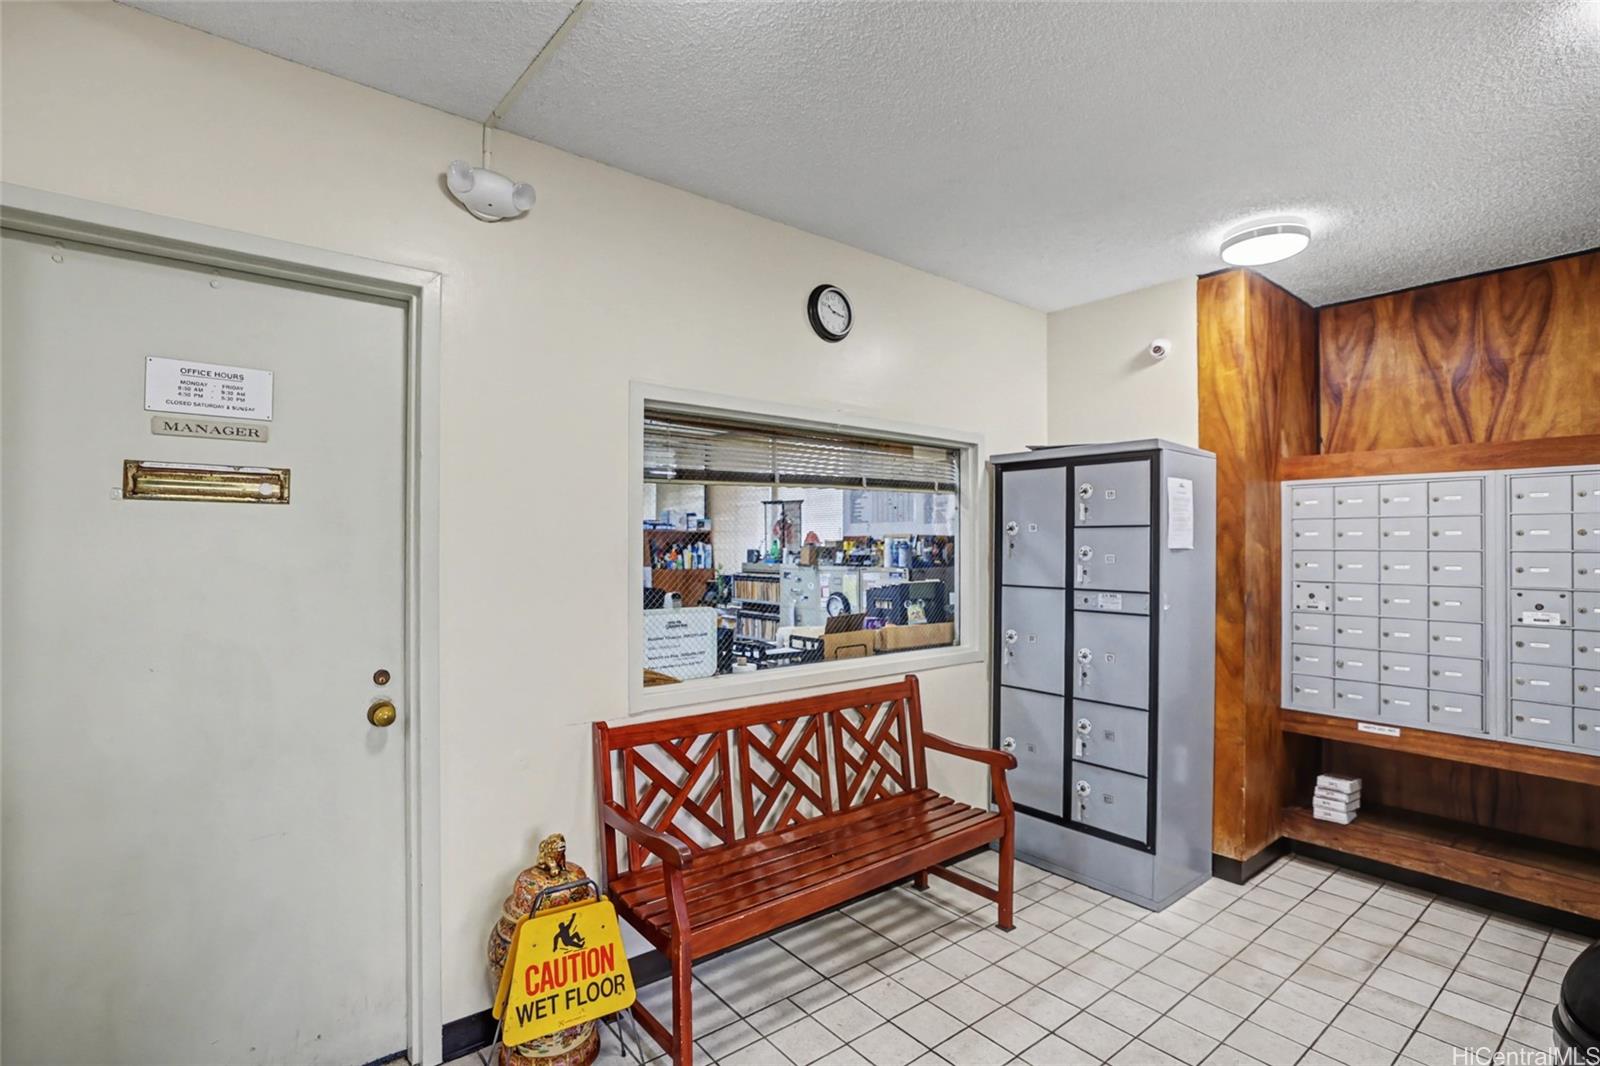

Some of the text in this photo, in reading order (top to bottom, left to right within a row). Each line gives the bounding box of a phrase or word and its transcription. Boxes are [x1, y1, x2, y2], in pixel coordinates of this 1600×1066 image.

[180, 367, 244, 380] OFFICE HOURS
[165, 399, 192, 407] CLOSED
[193, 401, 225, 409] SATURDAY
[163, 421, 261, 438] MANAGER
[525, 942, 615, 997] CAUTION
[515, 973, 626, 1028] WET FLOOR
